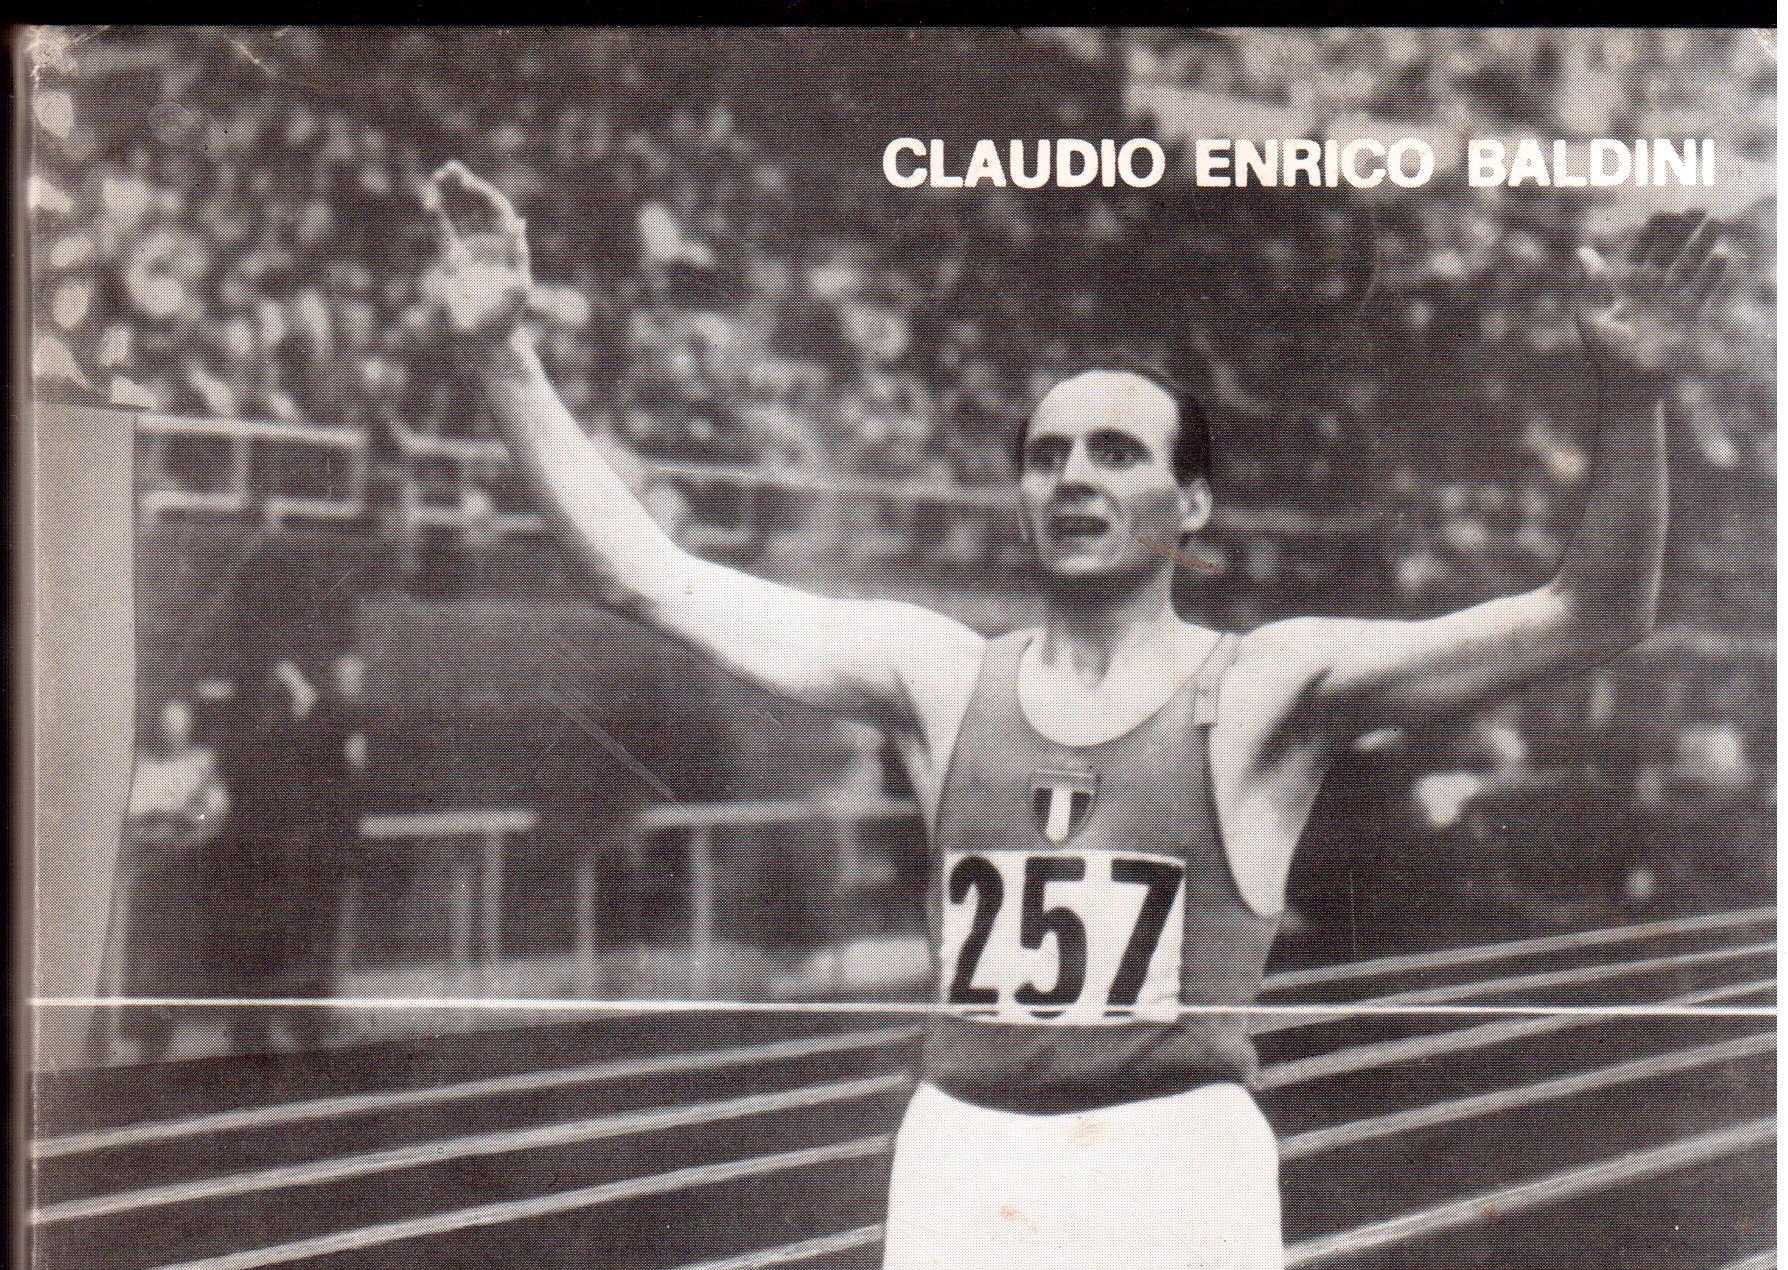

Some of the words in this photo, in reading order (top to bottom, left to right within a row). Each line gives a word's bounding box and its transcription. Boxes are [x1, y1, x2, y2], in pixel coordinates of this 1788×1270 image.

[882, 137, 1166, 188] CLAUDIO
[1195, 137, 1434, 188] ENRICO
[1467, 138, 1715, 188] BALDINI
[948, 855, 1186, 1017] 257
